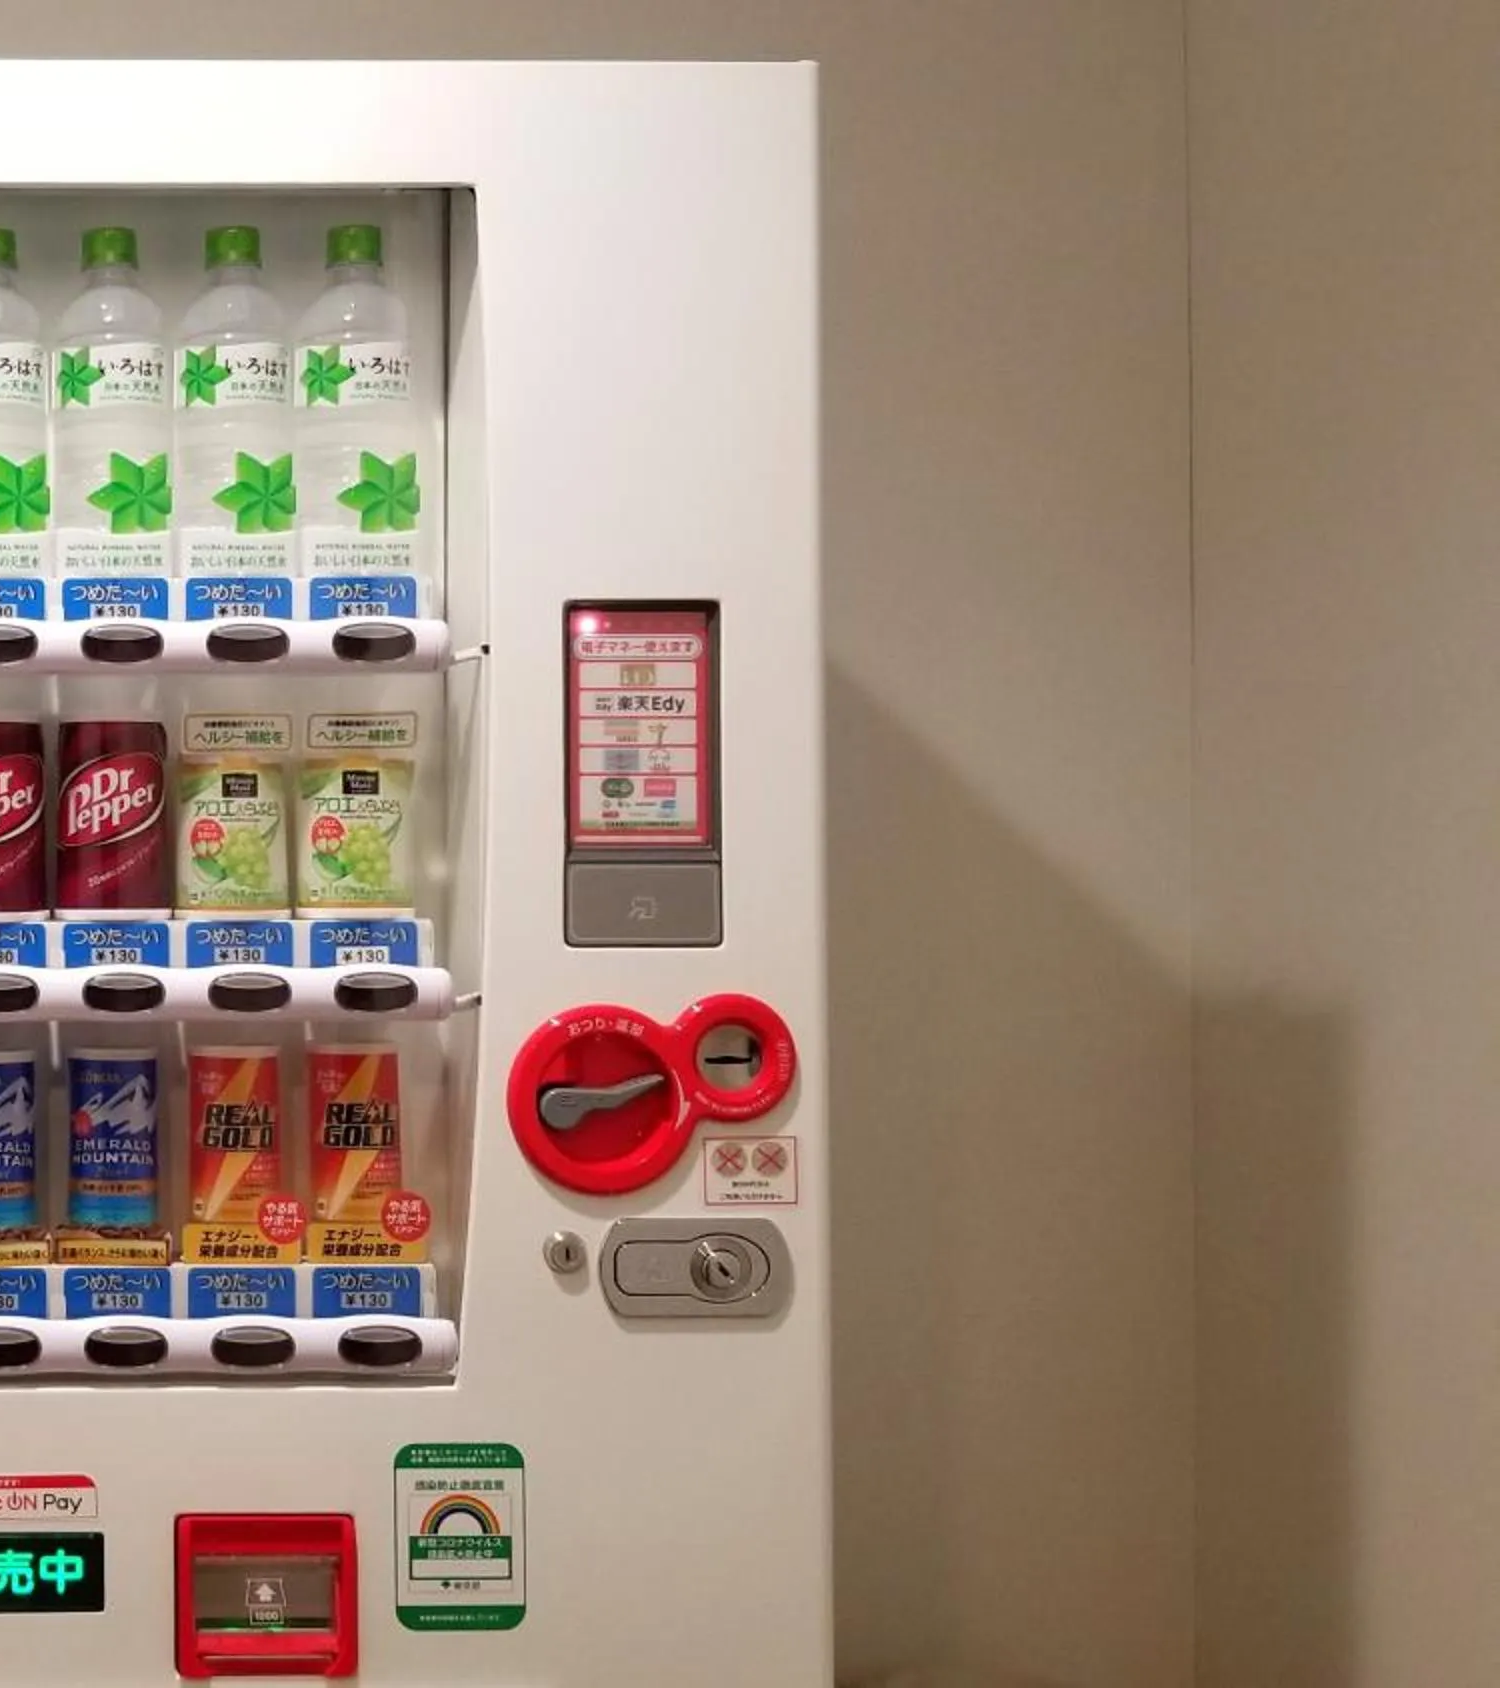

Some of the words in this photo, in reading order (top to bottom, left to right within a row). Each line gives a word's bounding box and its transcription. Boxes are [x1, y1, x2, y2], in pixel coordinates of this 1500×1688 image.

[618, 695, 685, 713] 楽天Edy
[92, 768, 135, 803] Dr
[67, 783, 156, 836] Pepper
[204, 1101, 275, 1125] REAL
[325, 1100, 396, 1124] REAL
[202, 1126, 273, 1149] GOLD
[324, 1125, 394, 1147] GOLD
[74, 1140, 151, 1153] EMERALD
[73, 1153, 153, 1166] MOUNTAIN
[263, 1215, 303, 1227] サポート
[385, 1213, 427, 1226] サポート
[199, 1245, 278, 1258] 栄養成分配合
[321, 1244, 402, 1257] 栄養成分配合
[44, 1494, 82, 1514] Pay
